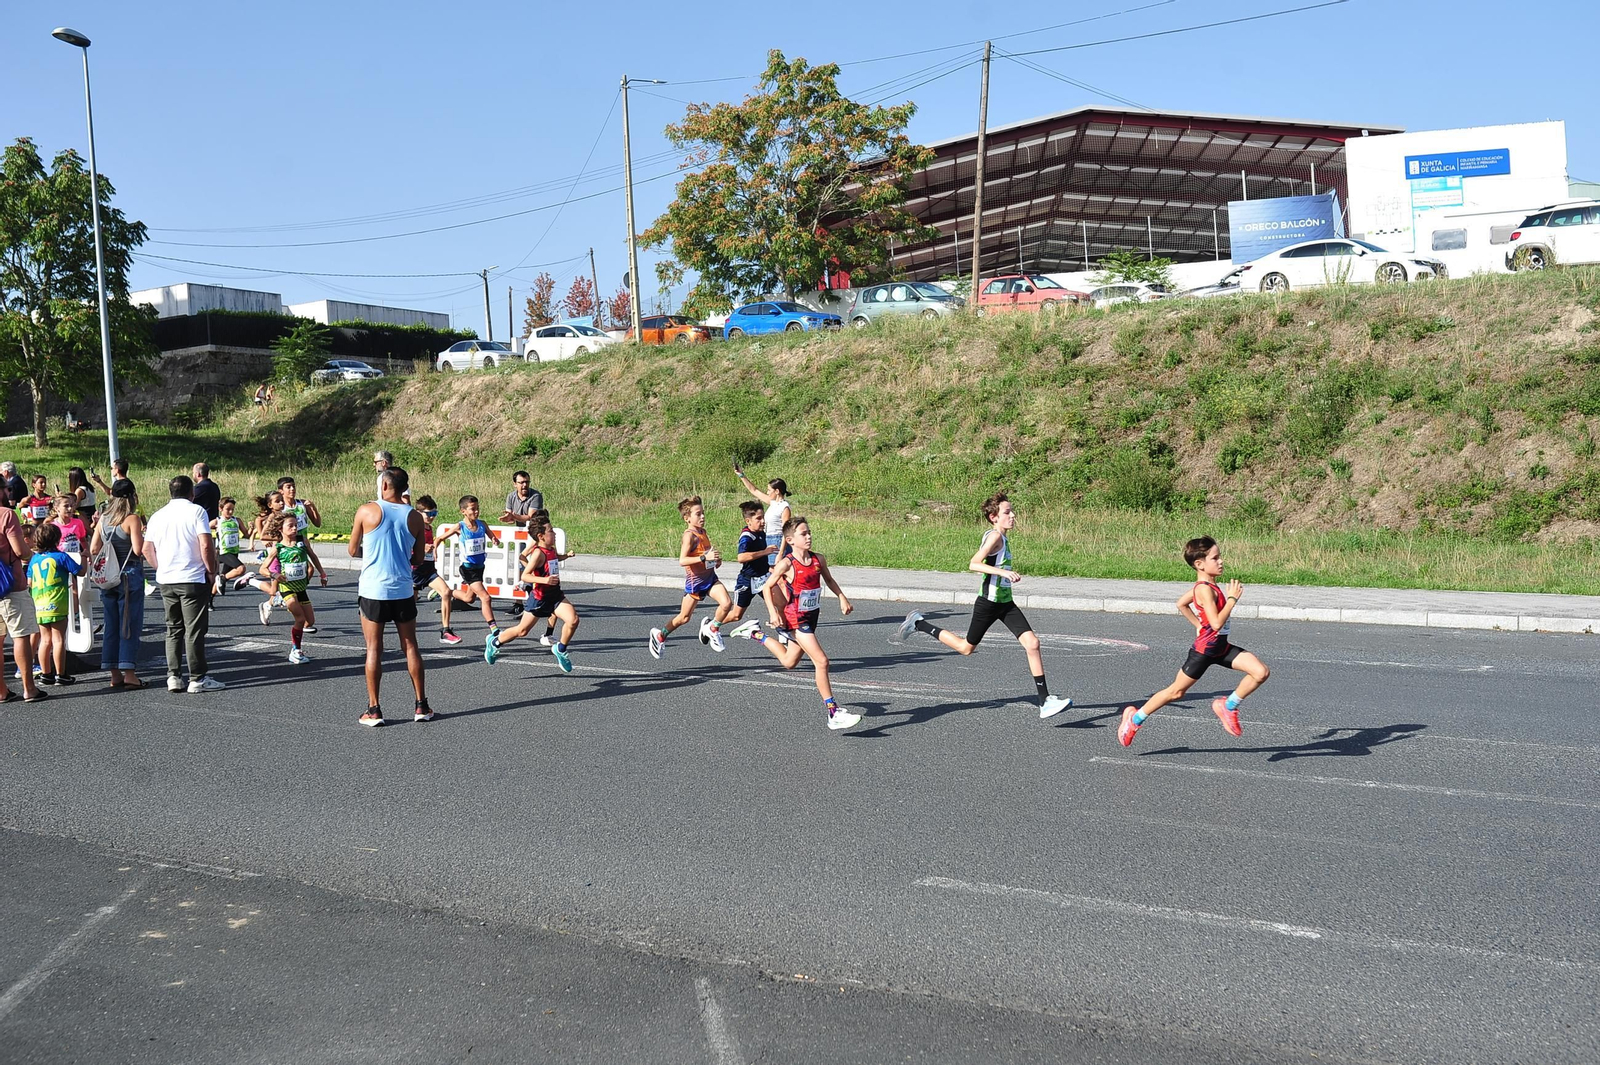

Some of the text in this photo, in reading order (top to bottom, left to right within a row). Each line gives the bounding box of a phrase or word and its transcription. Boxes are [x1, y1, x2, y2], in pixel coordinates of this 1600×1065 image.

[1430, 164, 1456, 173] GALICIA
[1244, 217, 1320, 232] ORECO BALGÓN
[1259, 233, 1306, 241] CONSTRUCTORA
[31, 557, 62, 590] 42
